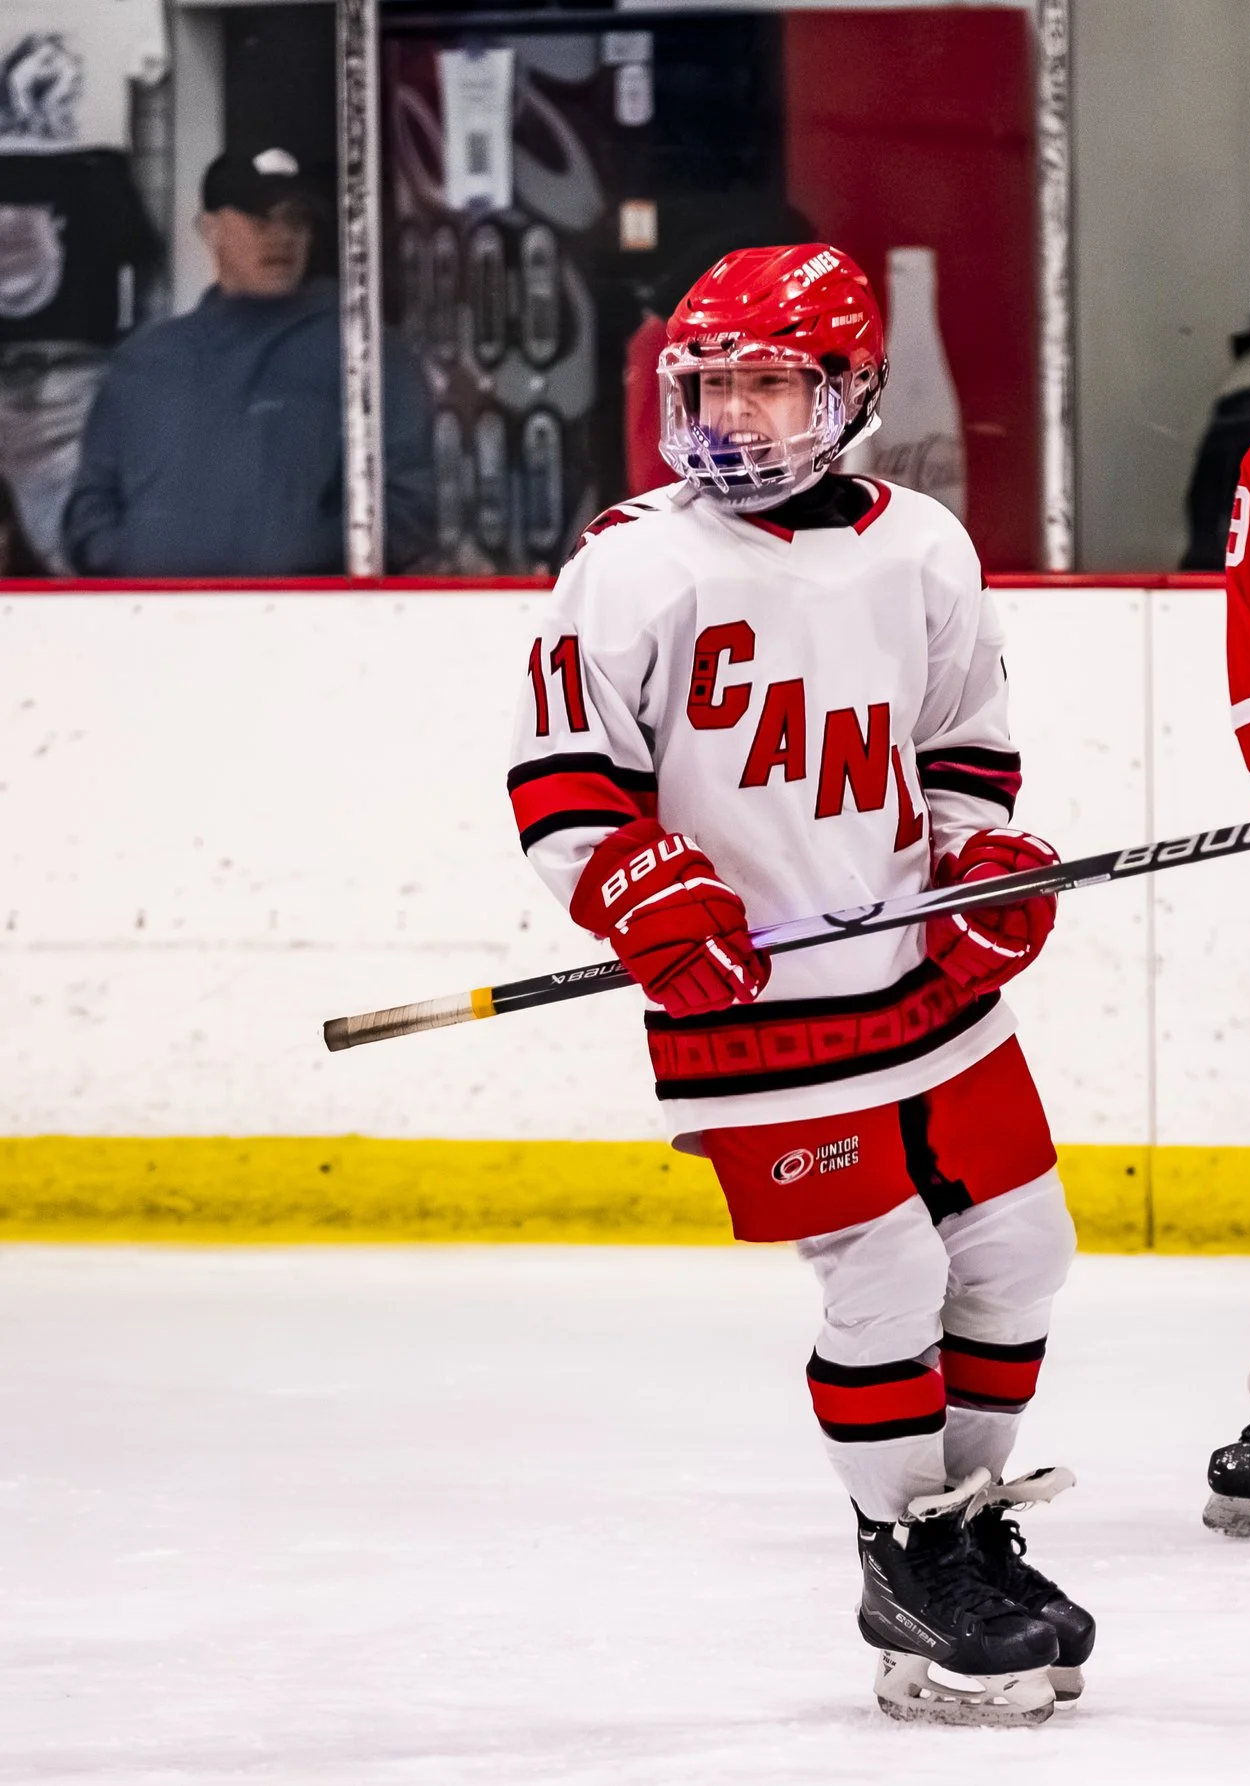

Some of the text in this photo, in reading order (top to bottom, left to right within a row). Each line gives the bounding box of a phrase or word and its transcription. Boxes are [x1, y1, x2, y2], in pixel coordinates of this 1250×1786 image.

[527, 634, 590, 737] 11
[815, 1135, 859, 1160] JUNIOR
[820, 1150, 859, 1174] CANES
